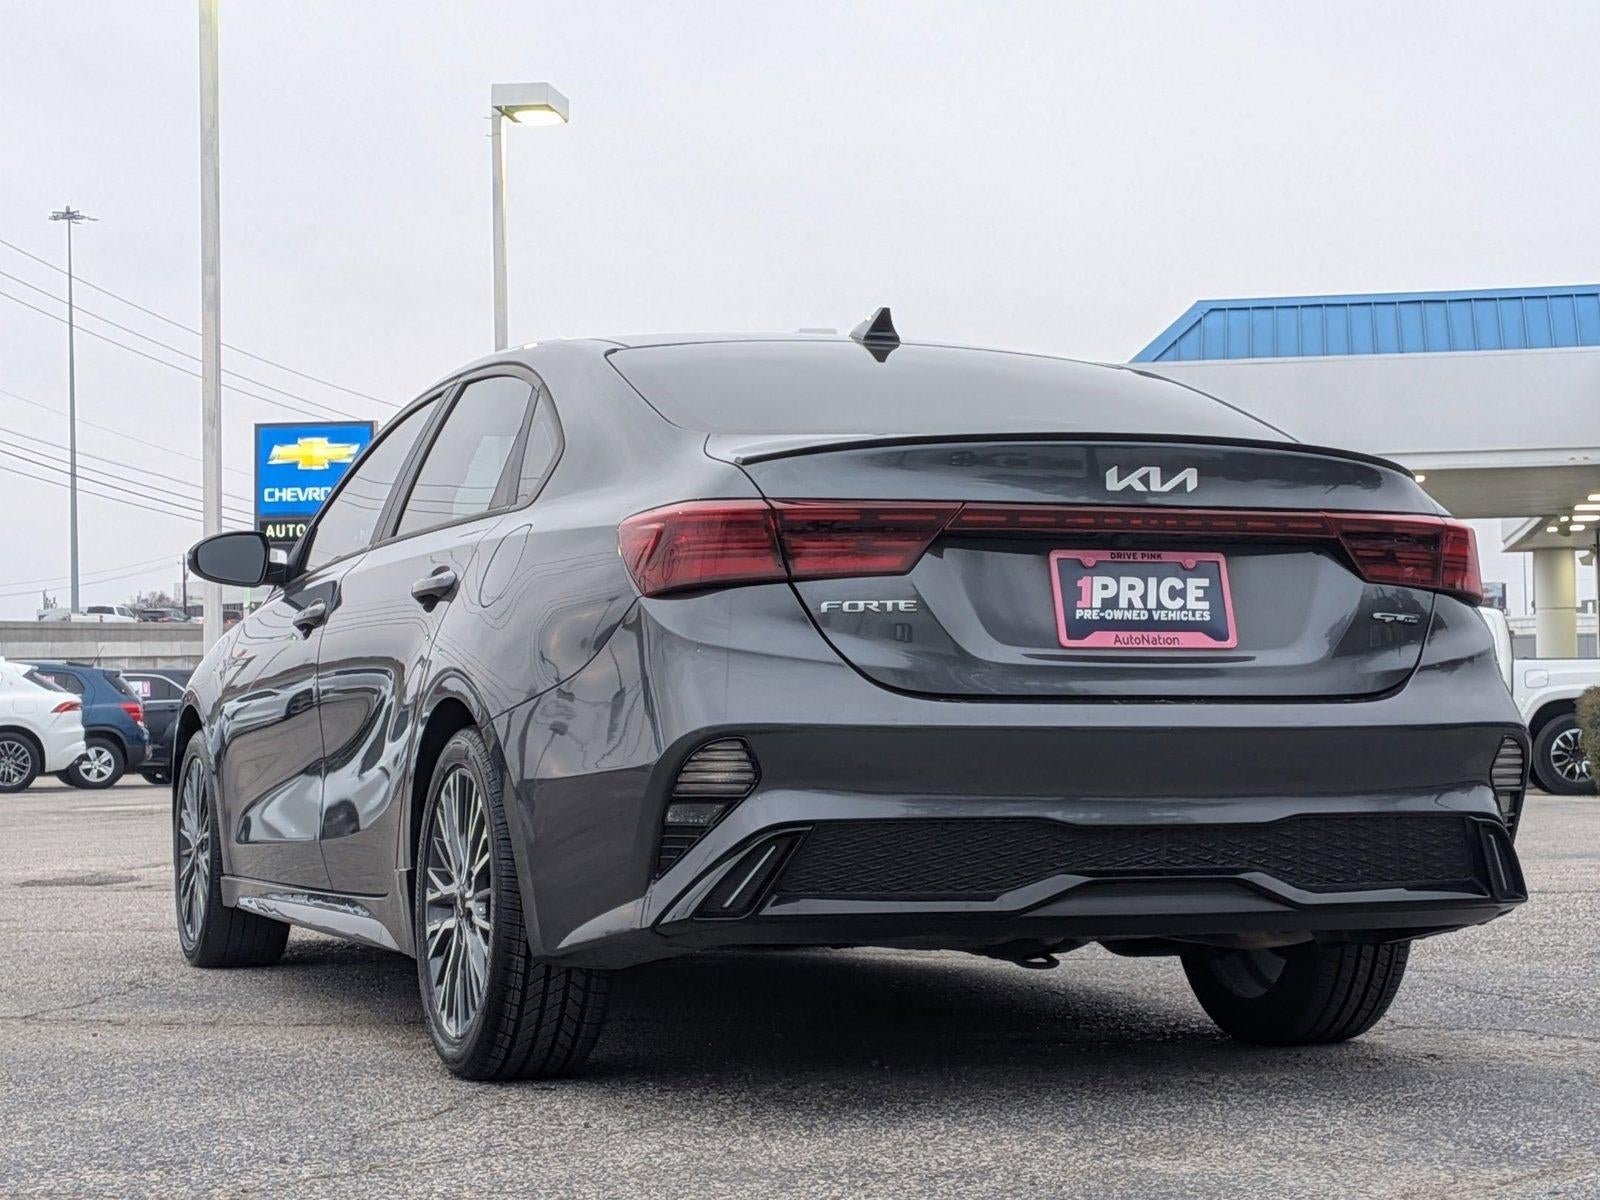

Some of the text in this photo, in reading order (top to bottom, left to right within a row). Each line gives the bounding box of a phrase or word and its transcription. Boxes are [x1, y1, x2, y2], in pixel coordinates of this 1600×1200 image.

[1105, 465, 1198, 493] KIA
[1110, 552, 1138, 560] DRIVE
[820, 600, 918, 614] FORTE
[1075, 609, 1211, 621] PRE-OWNED VEHICLES
[1113, 633, 1180, 646] AutoNation
